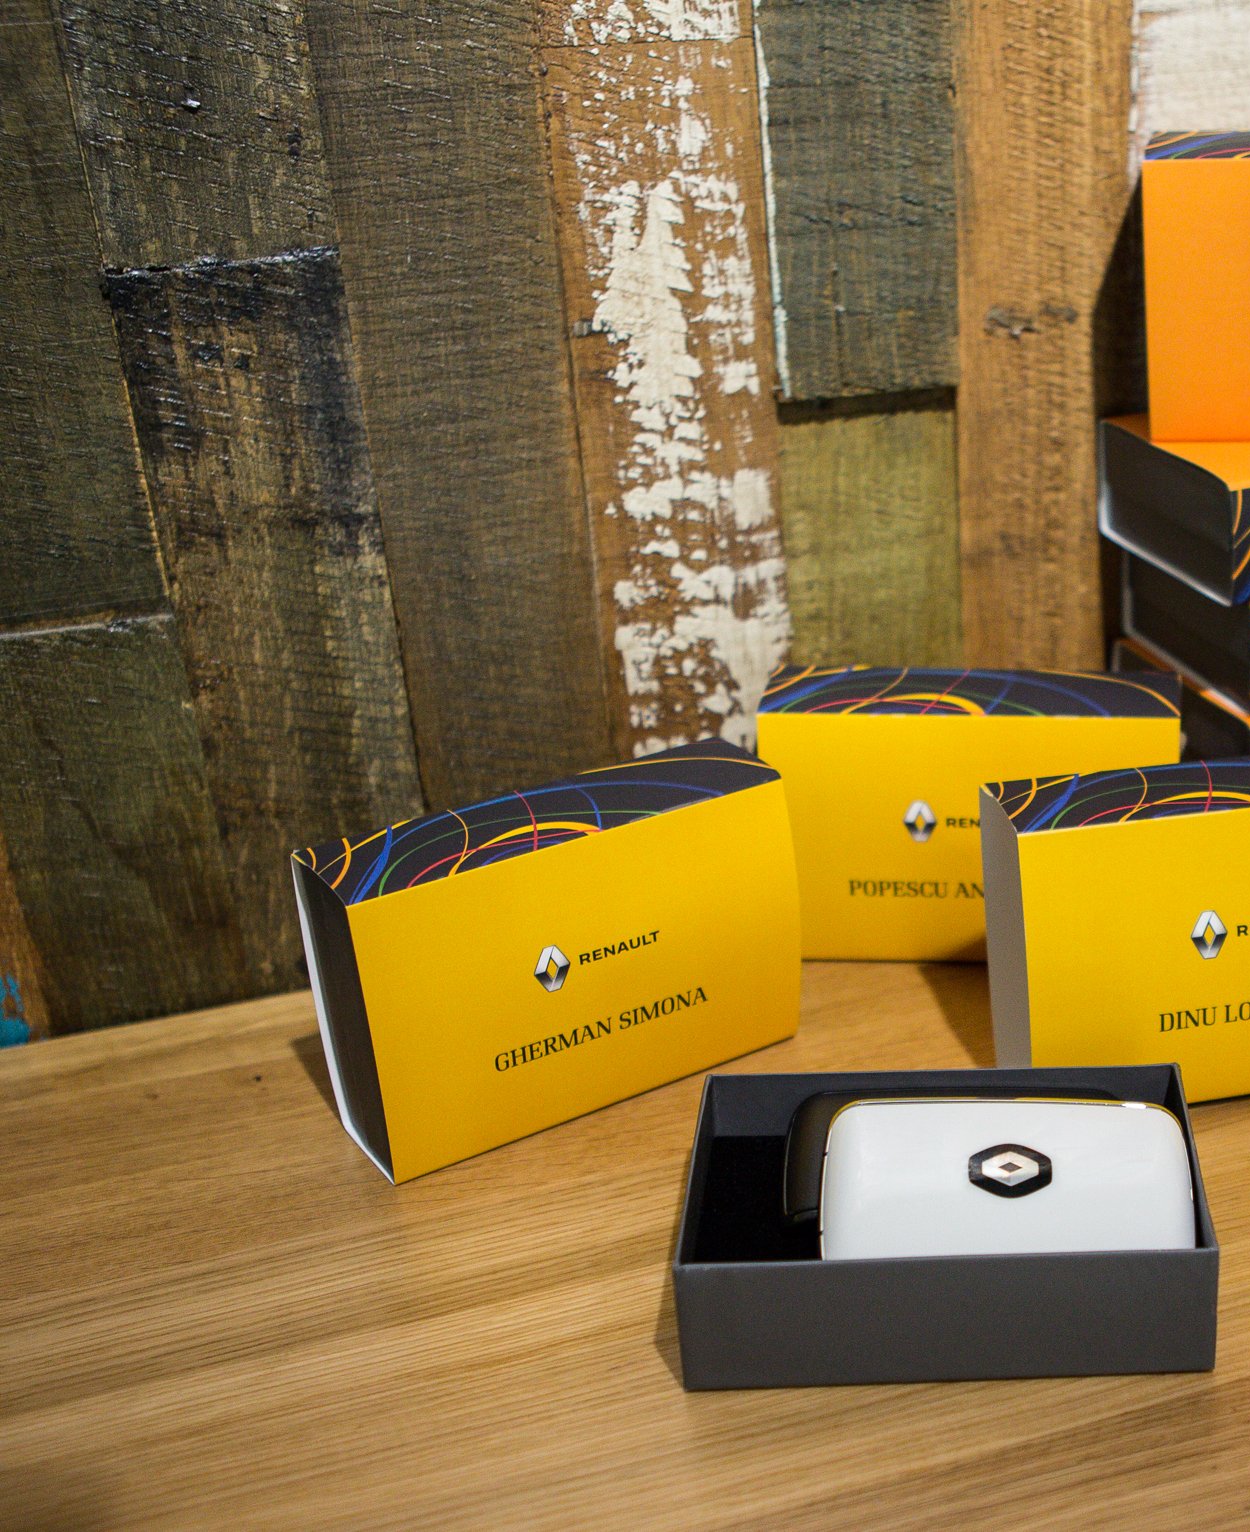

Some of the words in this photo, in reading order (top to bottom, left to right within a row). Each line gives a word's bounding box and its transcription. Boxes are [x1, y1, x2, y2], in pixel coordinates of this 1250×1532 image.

[848, 879, 948, 899] POPESCU
[578, 930, 660, 966] RENAULT
[494, 1016, 613, 1073] GHERMAN
[619, 986, 709, 1030] SIMONA
[1158, 1005, 1218, 1033] DINU
